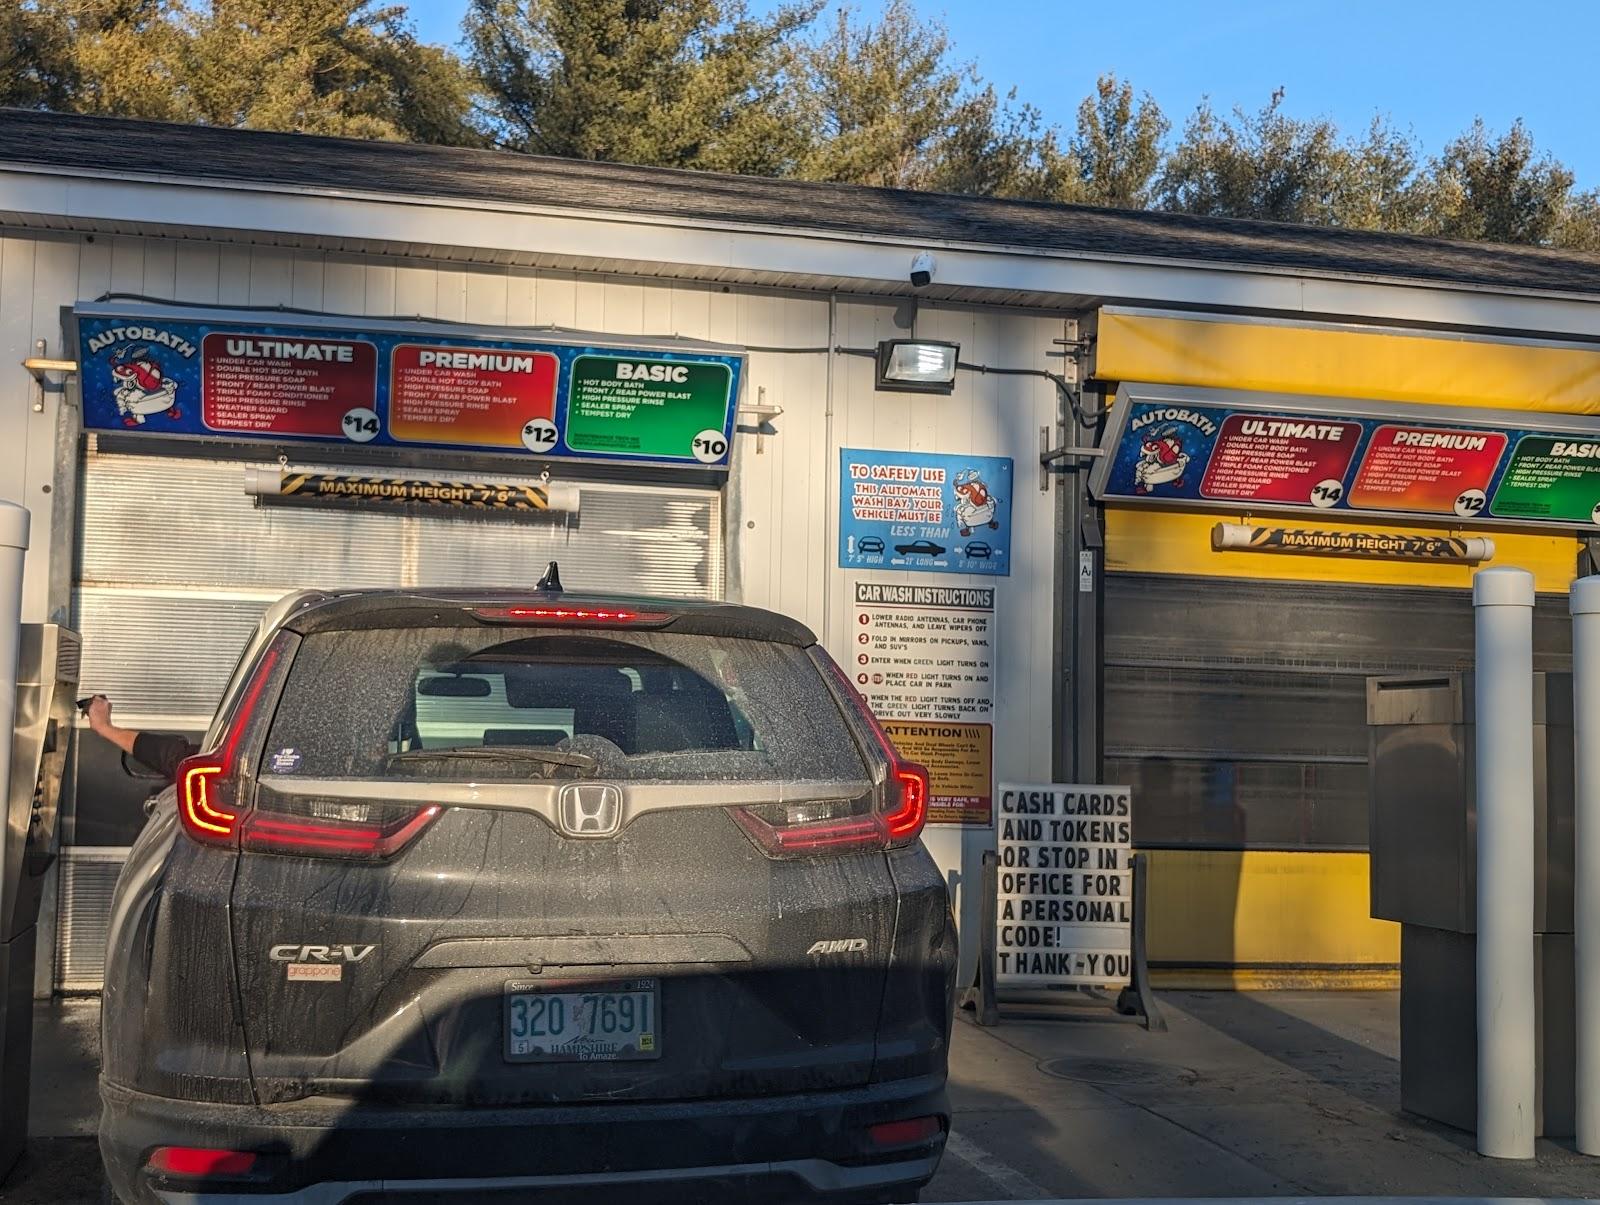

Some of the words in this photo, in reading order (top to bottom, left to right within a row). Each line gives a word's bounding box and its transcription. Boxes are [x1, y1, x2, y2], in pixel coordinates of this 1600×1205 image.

[88, 326, 196, 358] AUTOBATH
[226, 339, 354, 362] ULTIMATE
[419, 351, 534, 374] PREMIUM
[616, 363, 688, 383] BASIC
[602, 396, 640, 404] PRESSURE
[344, 416, 378, 433] $14
[1132, 408, 1216, 436] AUTOBATH
[1241, 420, 1344, 440] ULTIMATE
[524, 426, 556, 442] $12
[1393, 431, 1487, 451] PREMIUM
[693, 438, 726, 455] $10
[850, 465, 868, 478] TO
[872, 466, 918, 480] SAFELY
[923, 469, 944, 482] USE
[319, 480, 407, 497] MAXIMUM
[411, 484, 474, 500] HEIGHT
[855, 484, 877, 494] THIS
[880, 485, 941, 497] AUTOMATIC
[1313, 486, 1341, 501] $14
[853, 496, 884, 507] WASH
[914, 500, 942, 510] YOUR
[1458, 496, 1484, 510] $12
[854, 509, 894, 520] VEHICLE
[898, 511, 925, 521] MUST
[928, 512, 941, 522] BE
[890, 525, 916, 537] LESS
[920, 526, 950, 539] THAN
[1282, 534, 1353, 548] MAXIMUM
[1356, 536, 1407, 550] HEIGHT
[858, 585, 880, 600] CAR
[882, 586, 913, 602] WASH
[914, 587, 990, 606] INSTRUCTIONS
[886, 726, 962, 737] ATTENTION
[1002, 790, 1055, 814] CASH
[1064, 793, 1128, 816] CARDS
[1003, 819, 1042, 841] AND
[1050, 820, 1130, 842] TOKENS
[1004, 846, 1029, 868] OR
[1038, 847, 1089, 868] STOP
[1100, 848, 1117, 869] IN
[1002, 874, 1073, 894] OFFICE
[1083, 874, 1120, 896] FOR
[1003, 900, 1014, 920] A
[1021, 900, 1130, 922] PERSONAL
[1002, 926, 1060, 947] CODE!
[269, 944, 376, 961] CR-V
[806, 938, 868, 954] AWD
[511, 982, 534, 992] Since
[637, 980, 654, 989] 1924
[512, 997, 564, 1037] 320
[583, 994, 648, 1034] 7691
[552, 1043, 618, 1054] HAMPSHIRE
